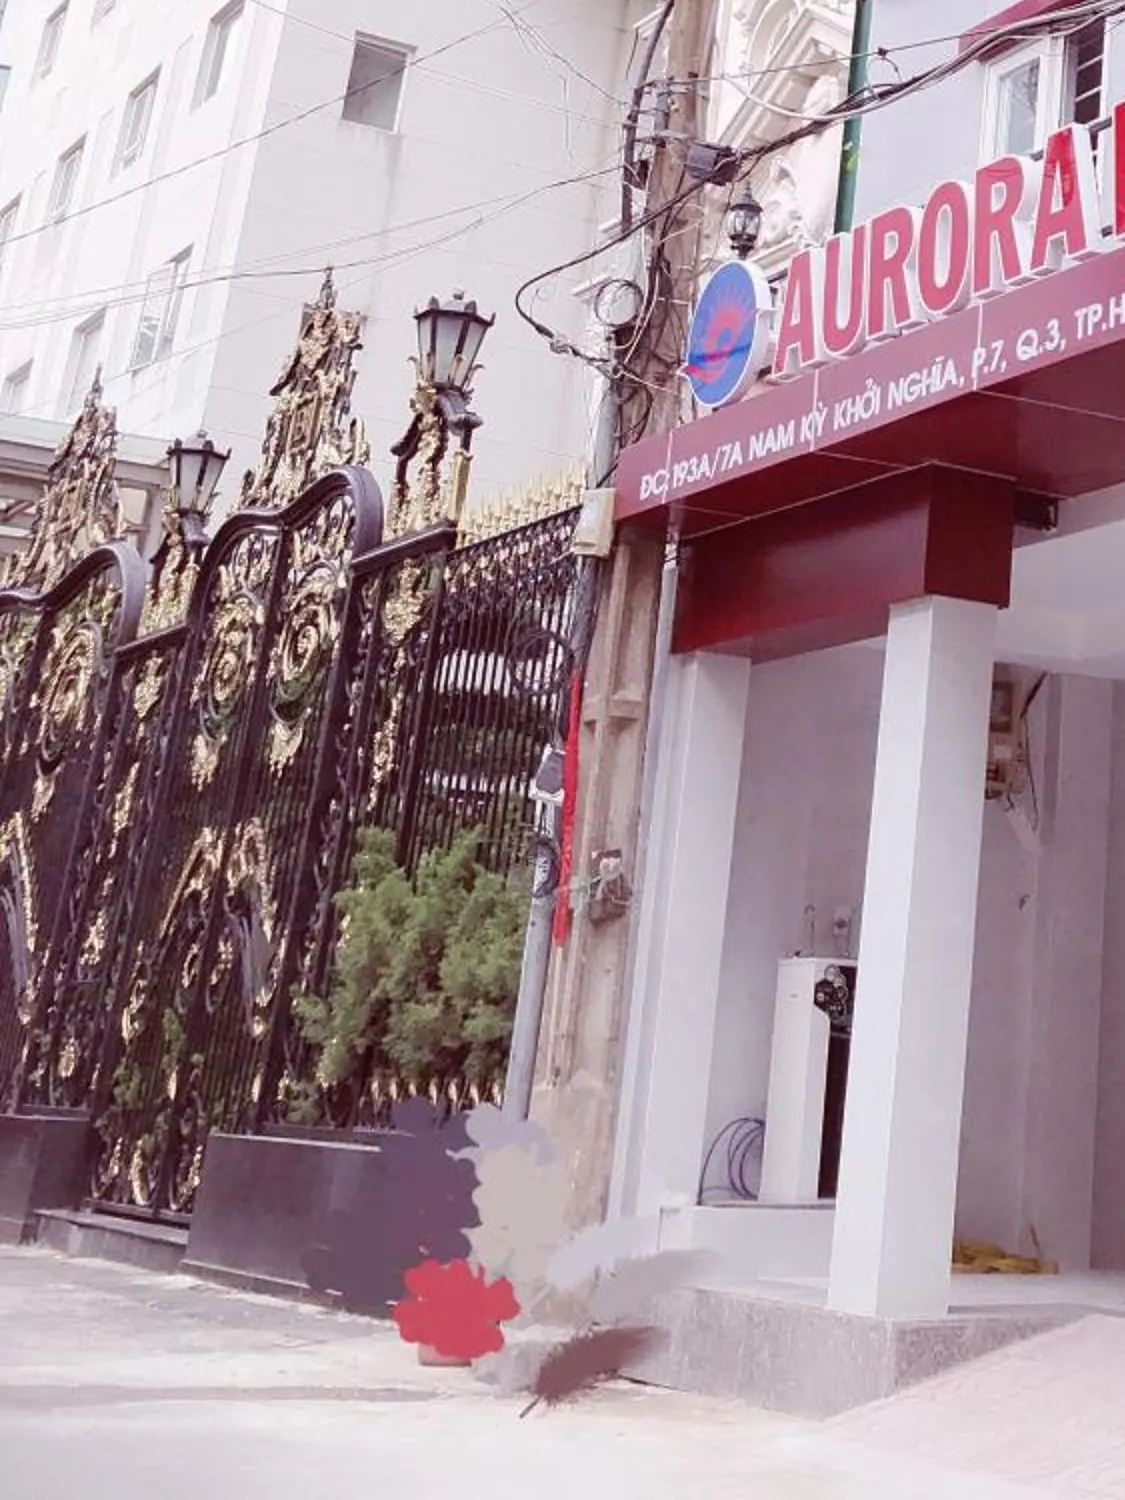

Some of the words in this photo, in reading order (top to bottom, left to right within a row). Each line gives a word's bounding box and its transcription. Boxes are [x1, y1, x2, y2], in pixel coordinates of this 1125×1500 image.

[771, 122, 1090, 380] AURORA
[673, 442, 744, 489] 193A/7A
[748, 419, 796, 461] NAM
[800, 401, 829, 443] KỲ
[833, 376, 881, 431] KHỞI
[970, 339, 1008, 380] P.7,
[1015, 318, 1067, 362] Q.3,
